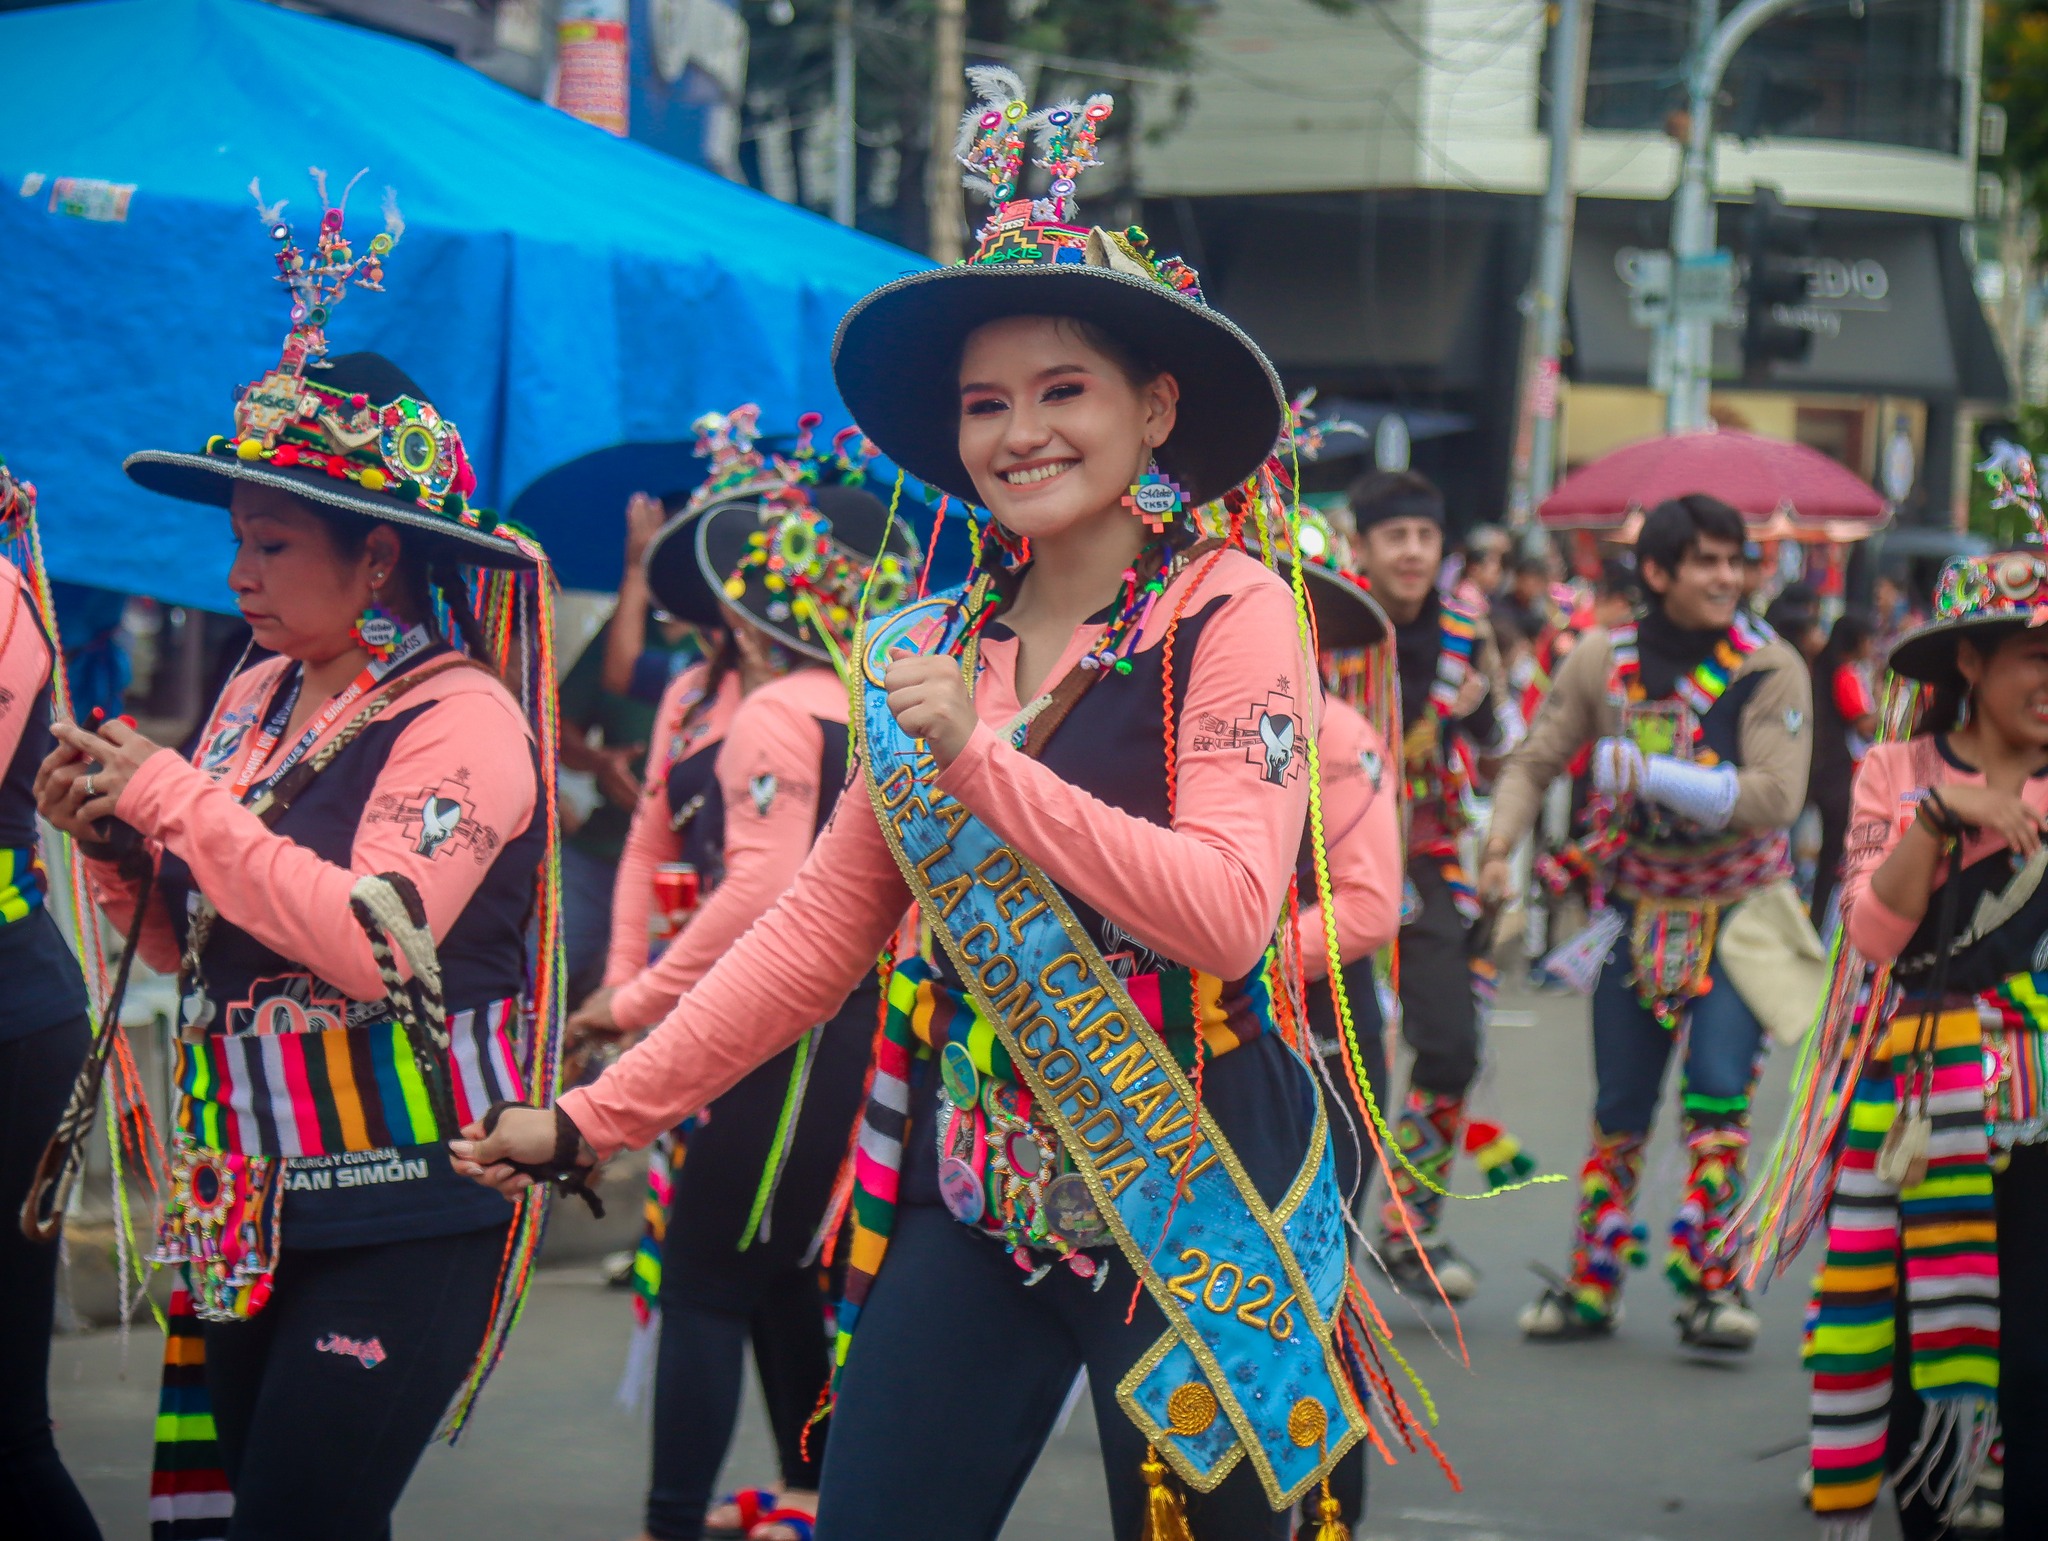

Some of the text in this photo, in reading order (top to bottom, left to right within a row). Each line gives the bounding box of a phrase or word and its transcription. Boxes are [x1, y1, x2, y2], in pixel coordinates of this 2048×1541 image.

[1143, 500, 1169, 509] TKSS
[266, 682, 362, 786] TINKUS SAN SIMON
[879, 763, 928, 840] DE
[916, 843, 974, 919] LA
[959, 921, 1149, 1200] CONCORDIA
[973, 847, 1050, 946] DEL
[1038, 951, 1219, 1204] CARNAVAL
[331, 1154, 343, 1167] Y
[335, 1157, 429, 1188] SIMÓN
[1166, 1247, 1297, 1342] 2026
